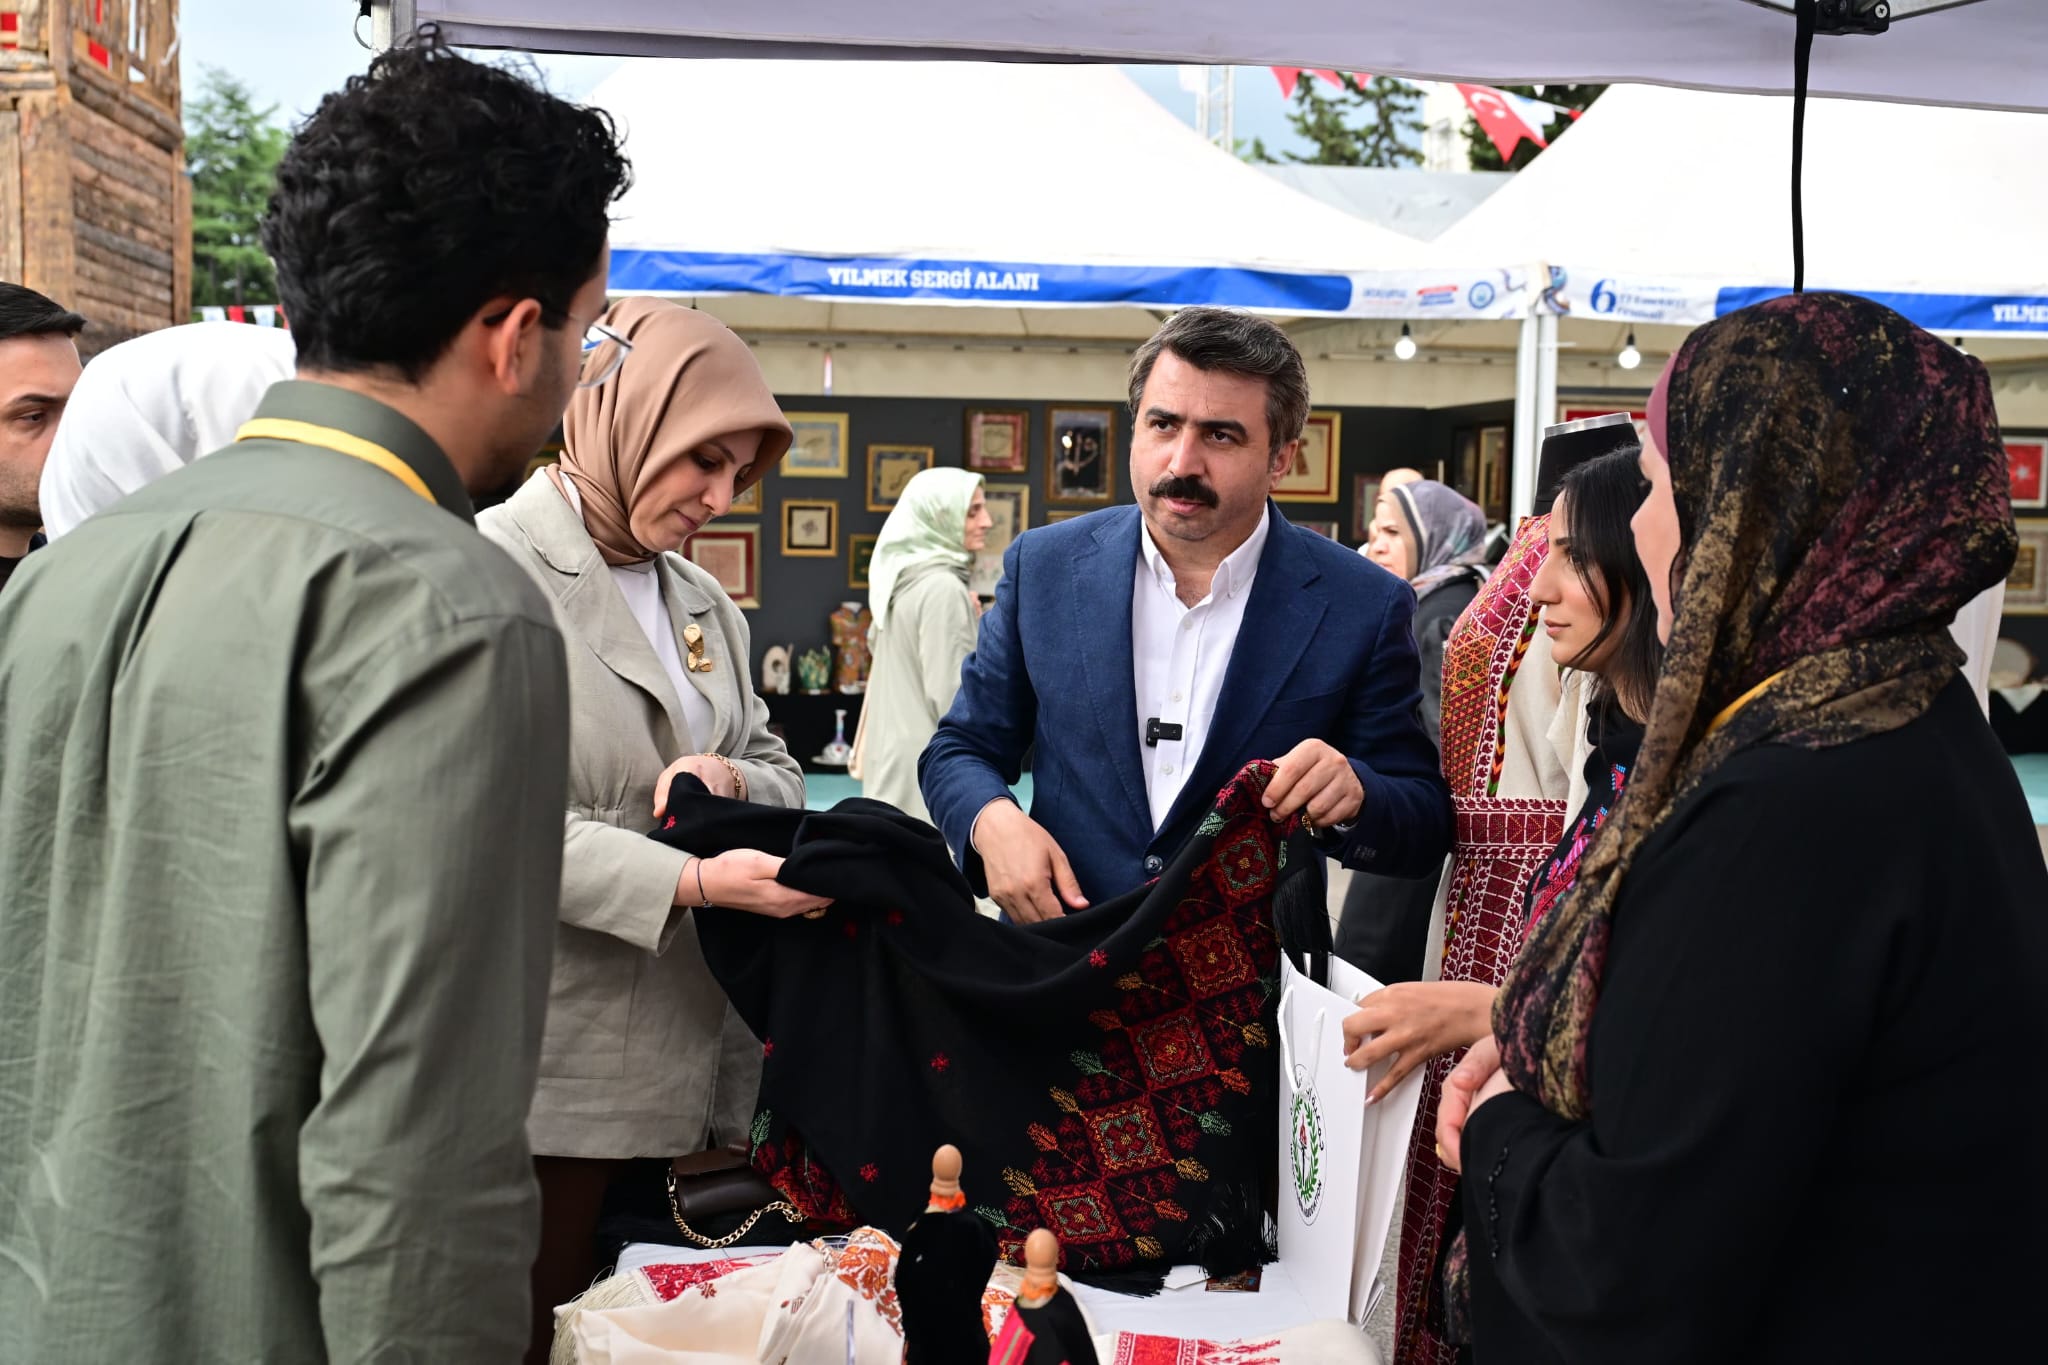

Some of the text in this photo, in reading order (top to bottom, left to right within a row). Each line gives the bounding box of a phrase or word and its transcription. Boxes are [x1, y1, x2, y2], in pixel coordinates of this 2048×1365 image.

[827, 267, 1040, 291] YILMEK SERGİ ALANI
